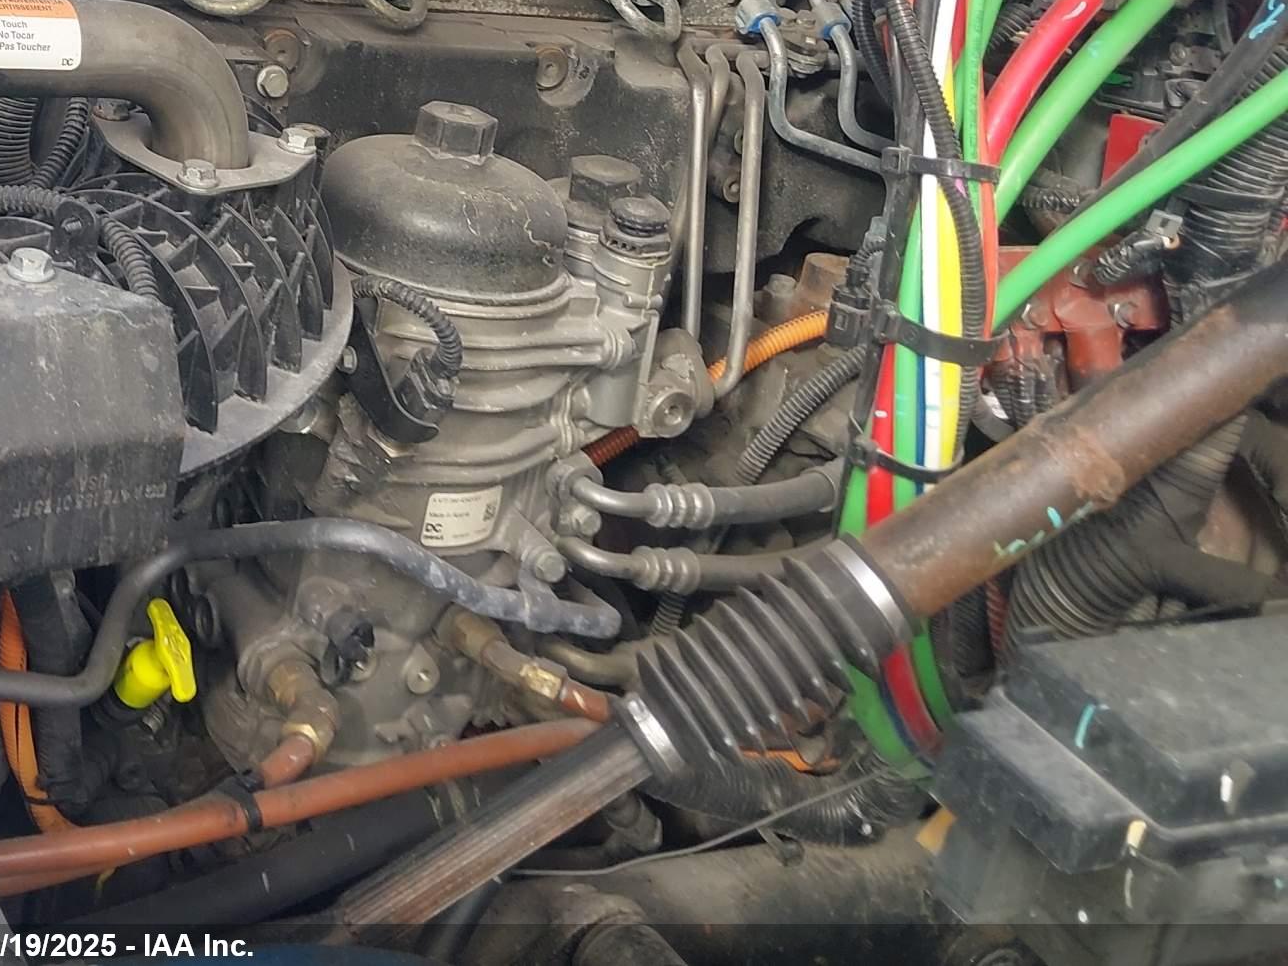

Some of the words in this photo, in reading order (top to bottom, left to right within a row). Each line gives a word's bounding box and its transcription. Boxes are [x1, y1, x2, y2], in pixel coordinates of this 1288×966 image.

[2, 19, 28, 28] Touch
[11, 31, 35, 40] Tocar
[0, 42, 15, 51] Pas
[16, 42, 51, 52] Toucher
[61, 58, 74, 67] DC
[425, 522, 443, 533] DC
